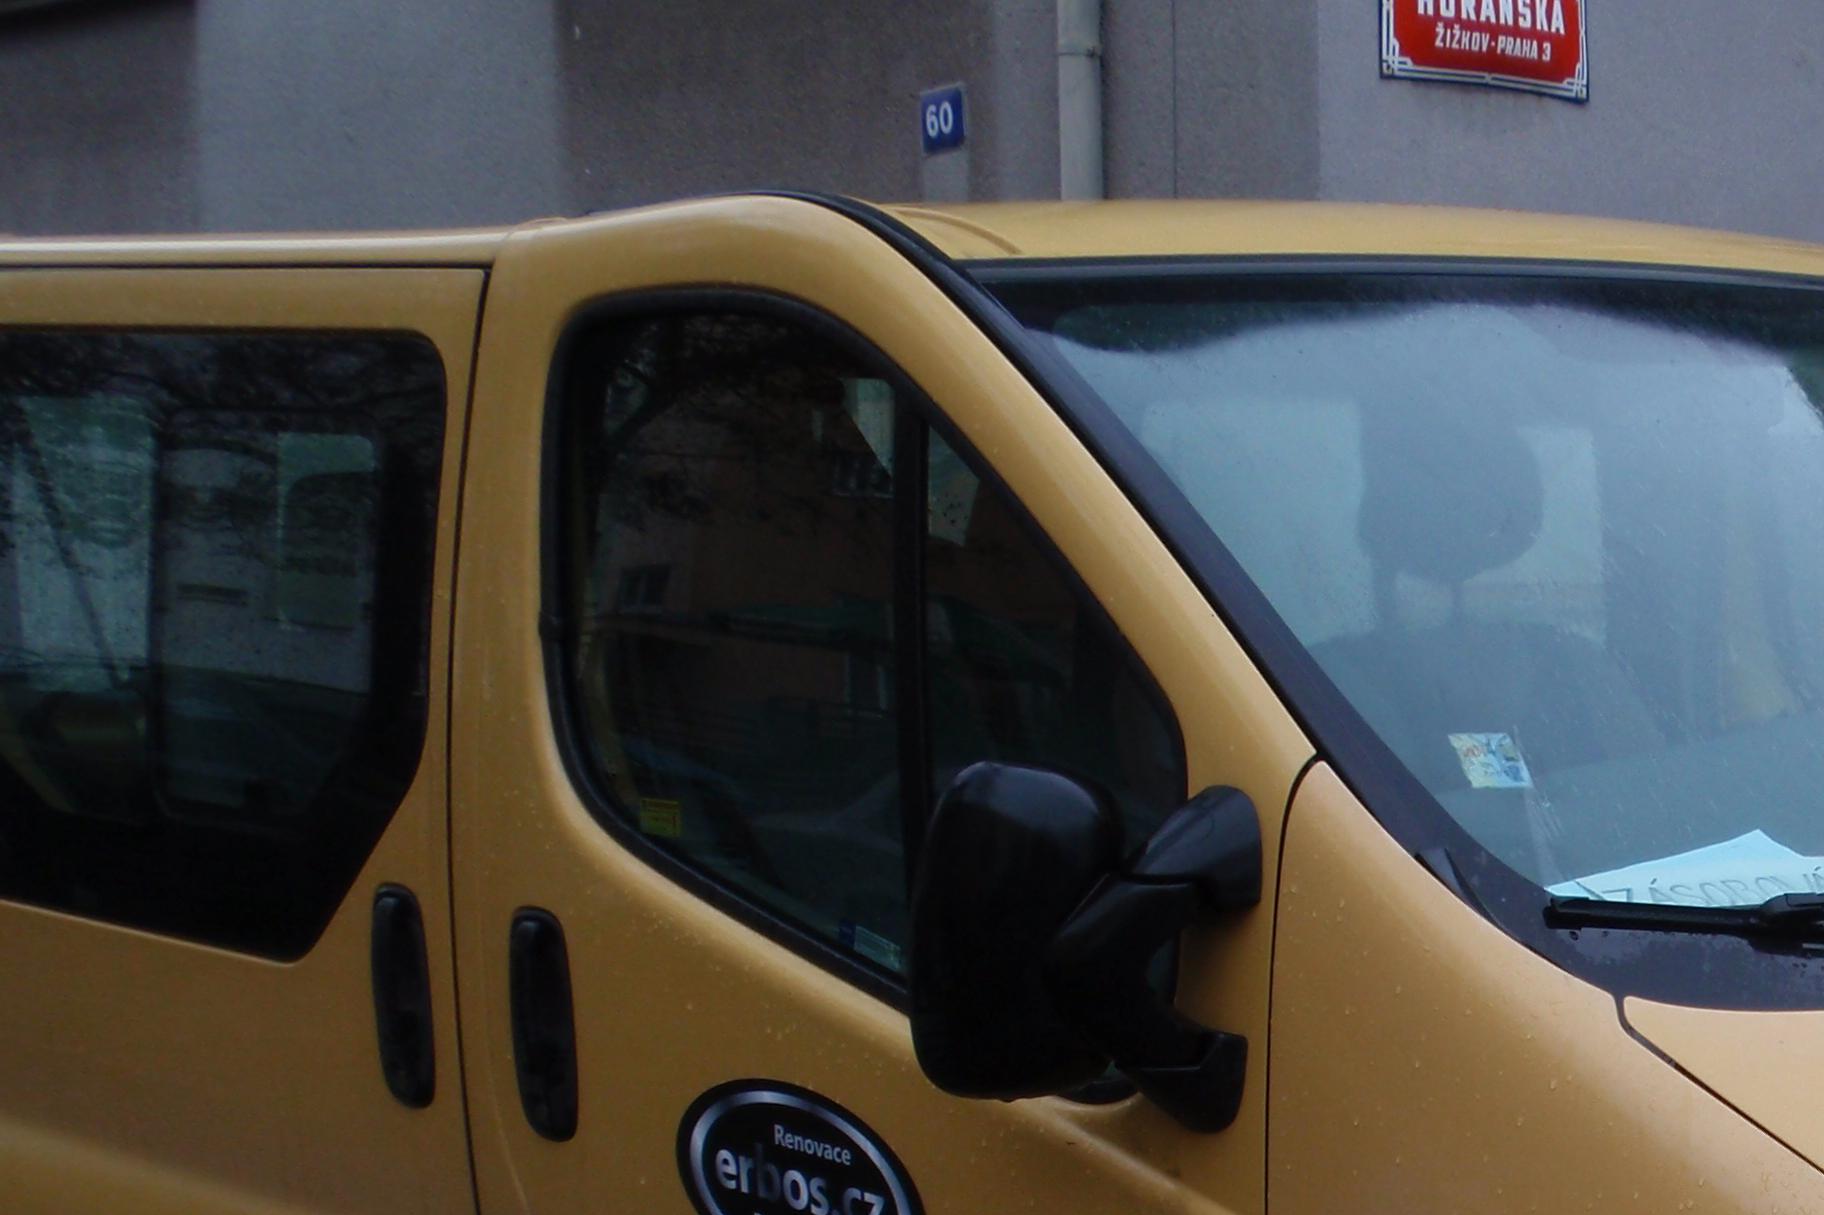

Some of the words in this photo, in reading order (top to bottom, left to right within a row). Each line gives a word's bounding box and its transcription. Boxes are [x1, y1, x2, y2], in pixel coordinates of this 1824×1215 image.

[1542, 41, 1551, 61] 3
[926, 101, 953, 138] 60
[773, 1124, 851, 1165] Renovace
